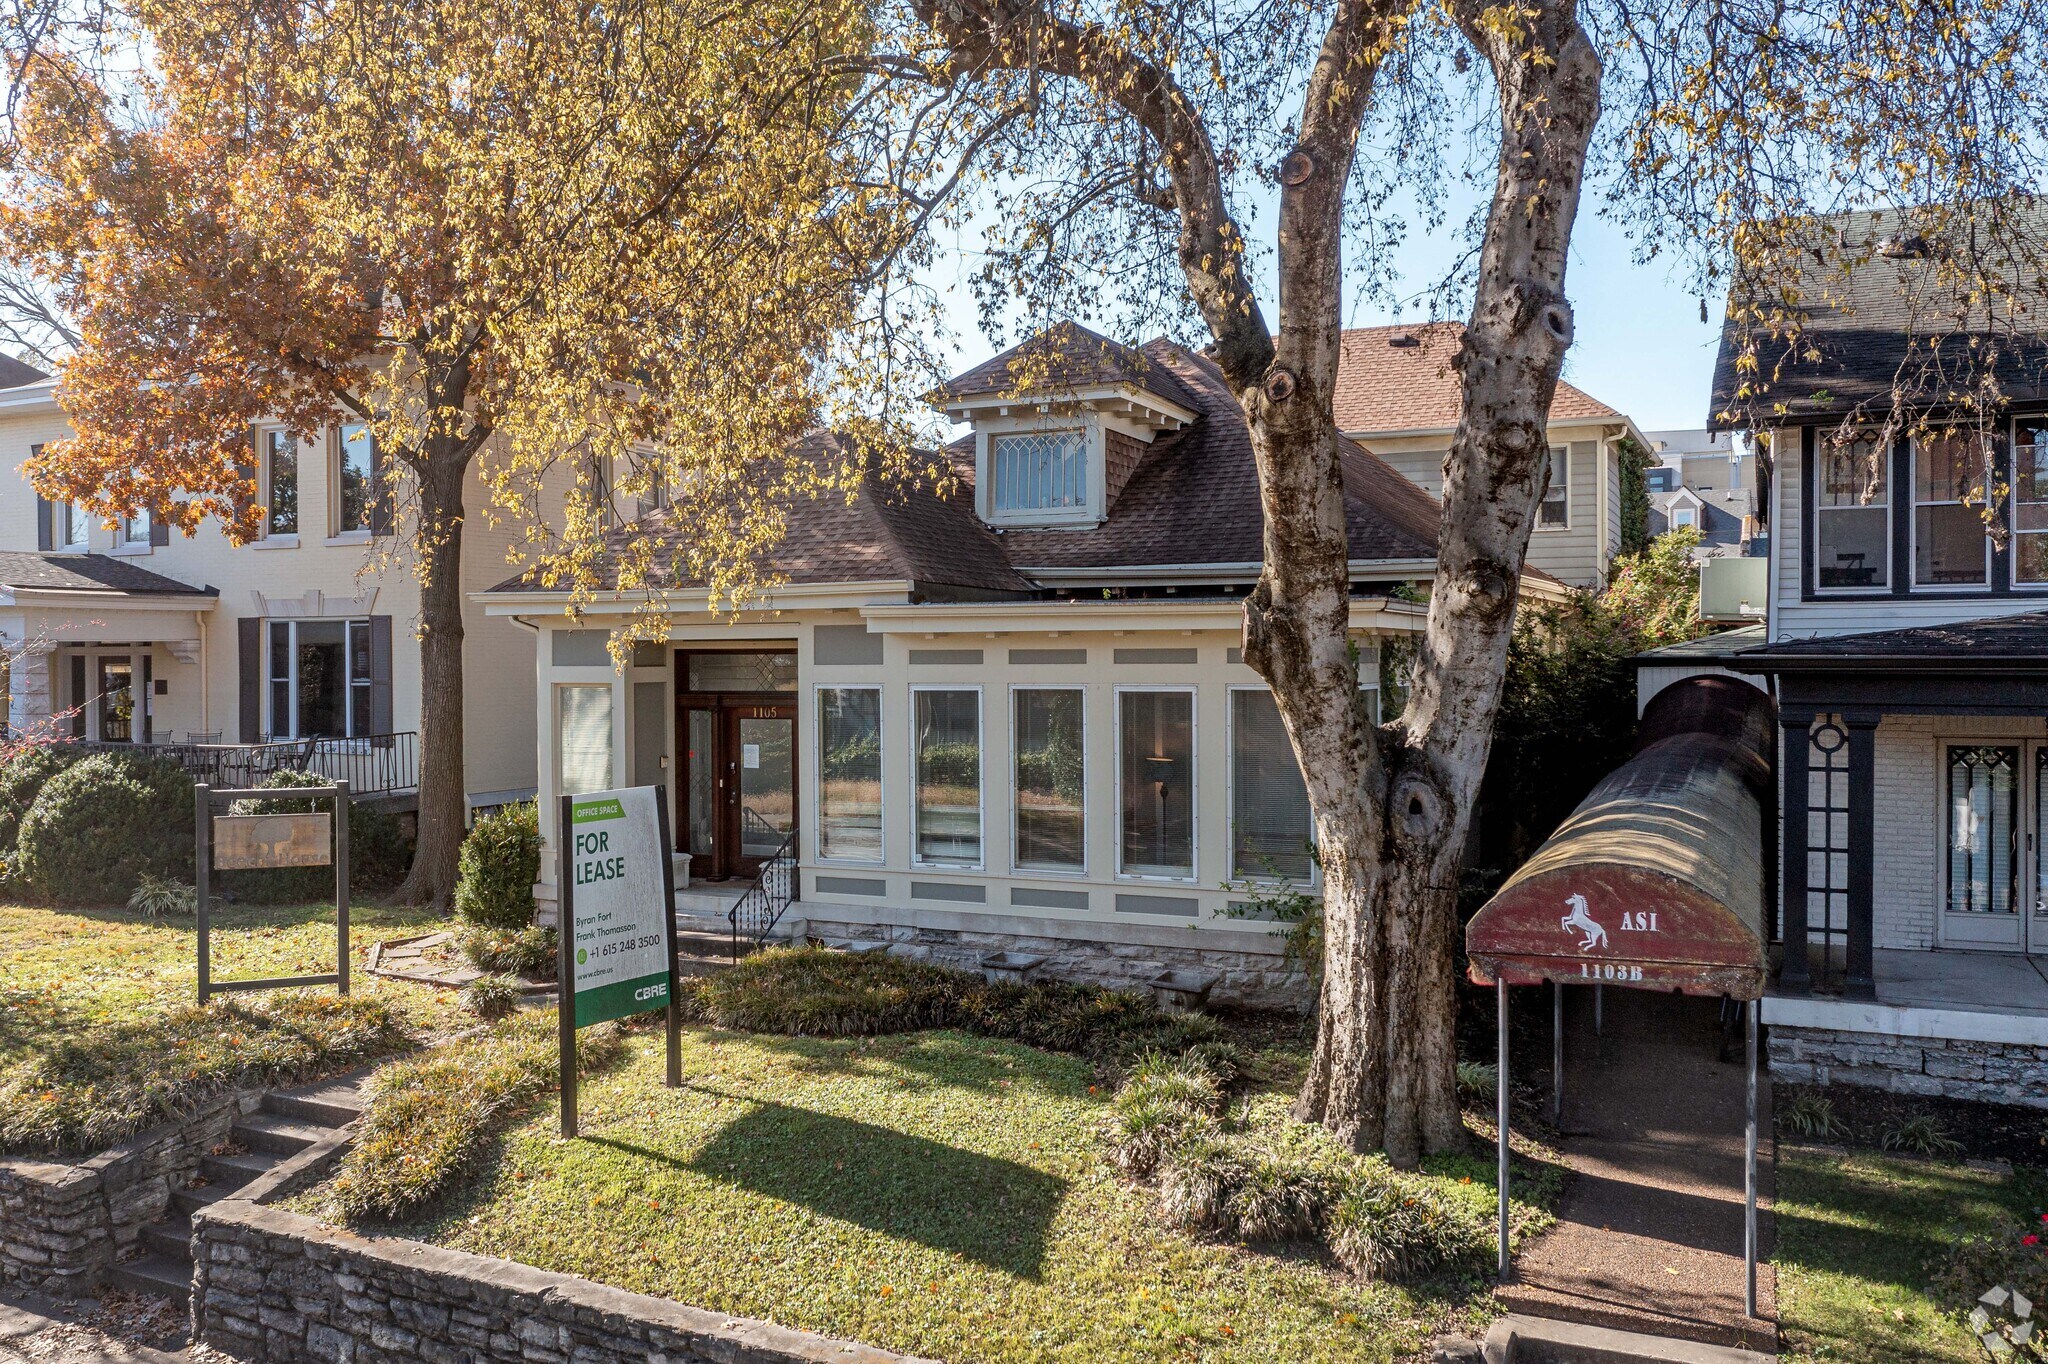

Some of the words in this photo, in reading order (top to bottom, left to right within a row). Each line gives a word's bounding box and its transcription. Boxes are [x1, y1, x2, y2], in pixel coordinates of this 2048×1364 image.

[753, 707, 777, 718] 1105
[576, 807, 598, 818] OFFICE
[599, 805, 618, 815] SPACE
[576, 831, 609, 856] FOR
[576, 857, 625, 885] LEASE
[598, 912, 612, 922] Fort
[576, 930, 596, 942] Frank
[597, 923, 637, 937] Thomasson
[590, 946, 599, 959] +1
[602, 943, 617, 957] 615
[620, 939, 636, 953] 248
[638, 934, 660, 949] 3500
[1580, 963, 1643, 981] 1103B
[634, 983, 667, 1001] CBRE
